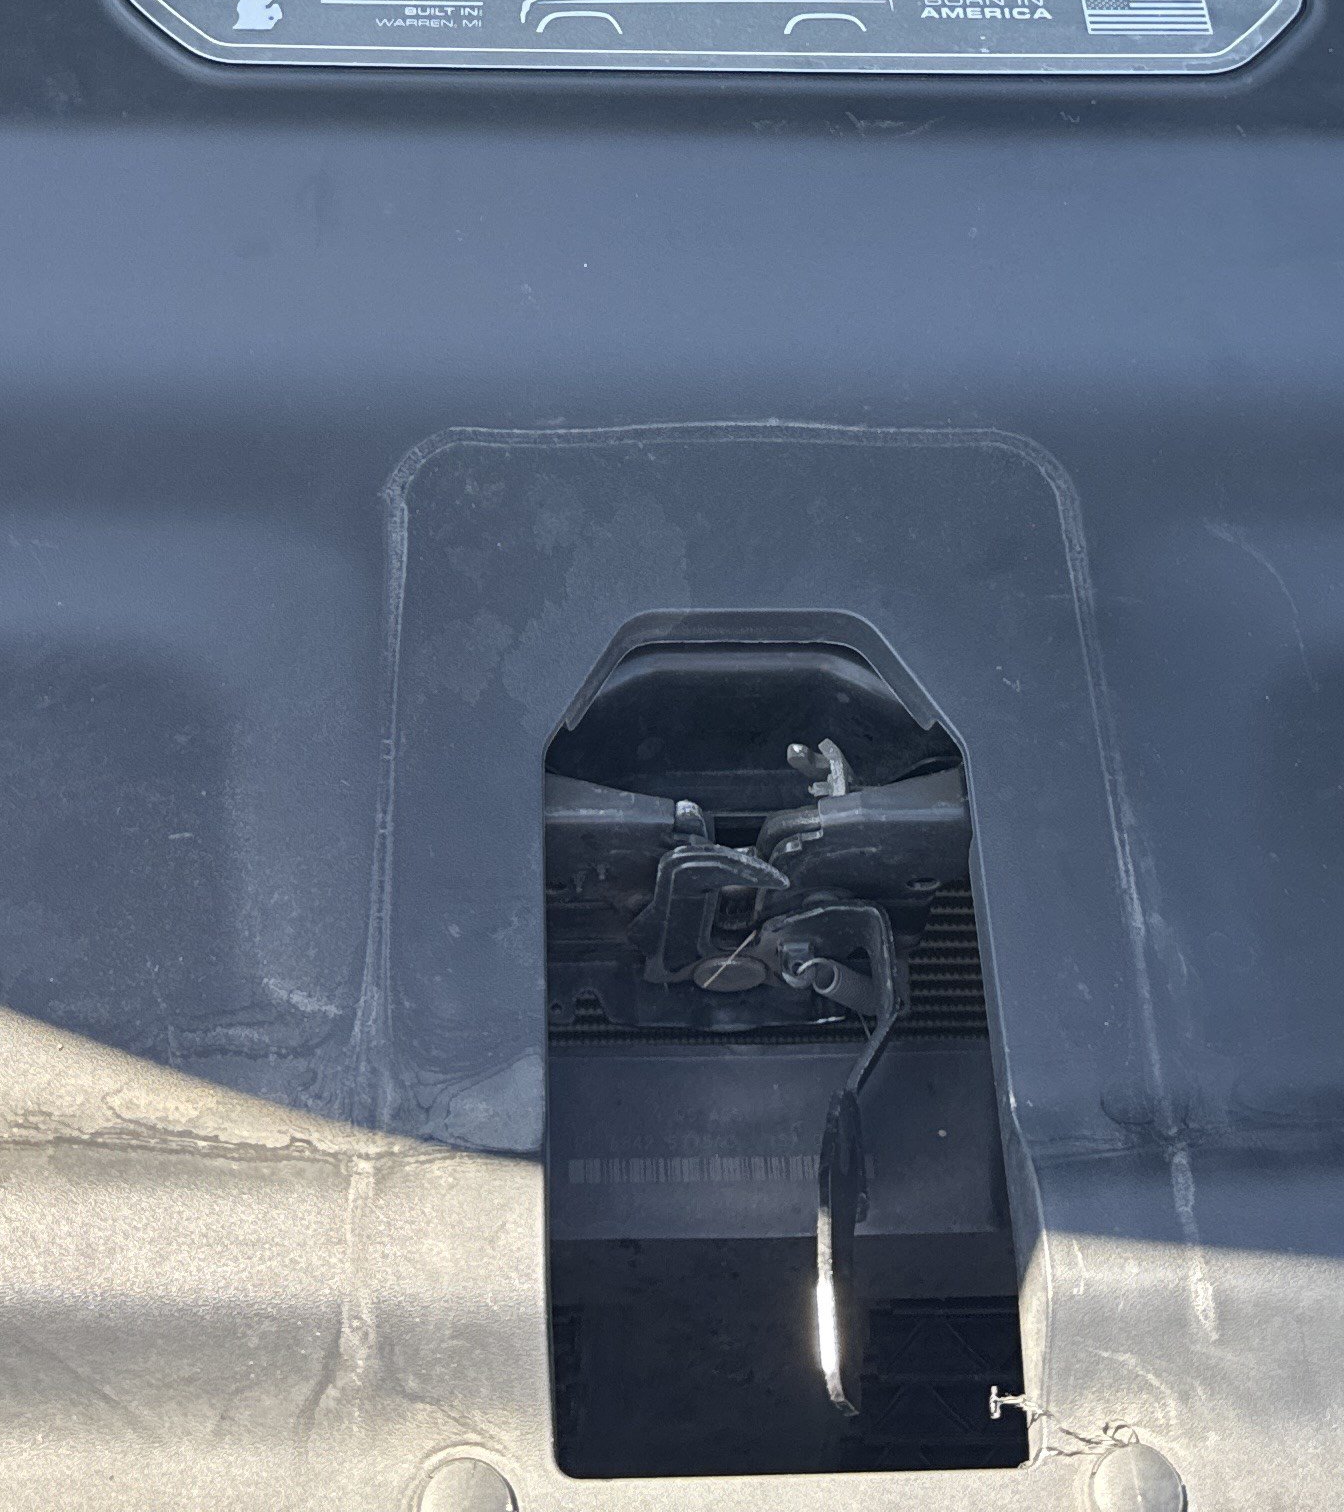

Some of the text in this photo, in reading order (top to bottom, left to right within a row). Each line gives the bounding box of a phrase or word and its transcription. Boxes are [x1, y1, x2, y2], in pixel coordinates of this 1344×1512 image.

[404, 6, 483, 17] BUILT IN:
[920, 6, 1053, 20] AMERICA
[375, 18, 483, 29] WARREN, MI
